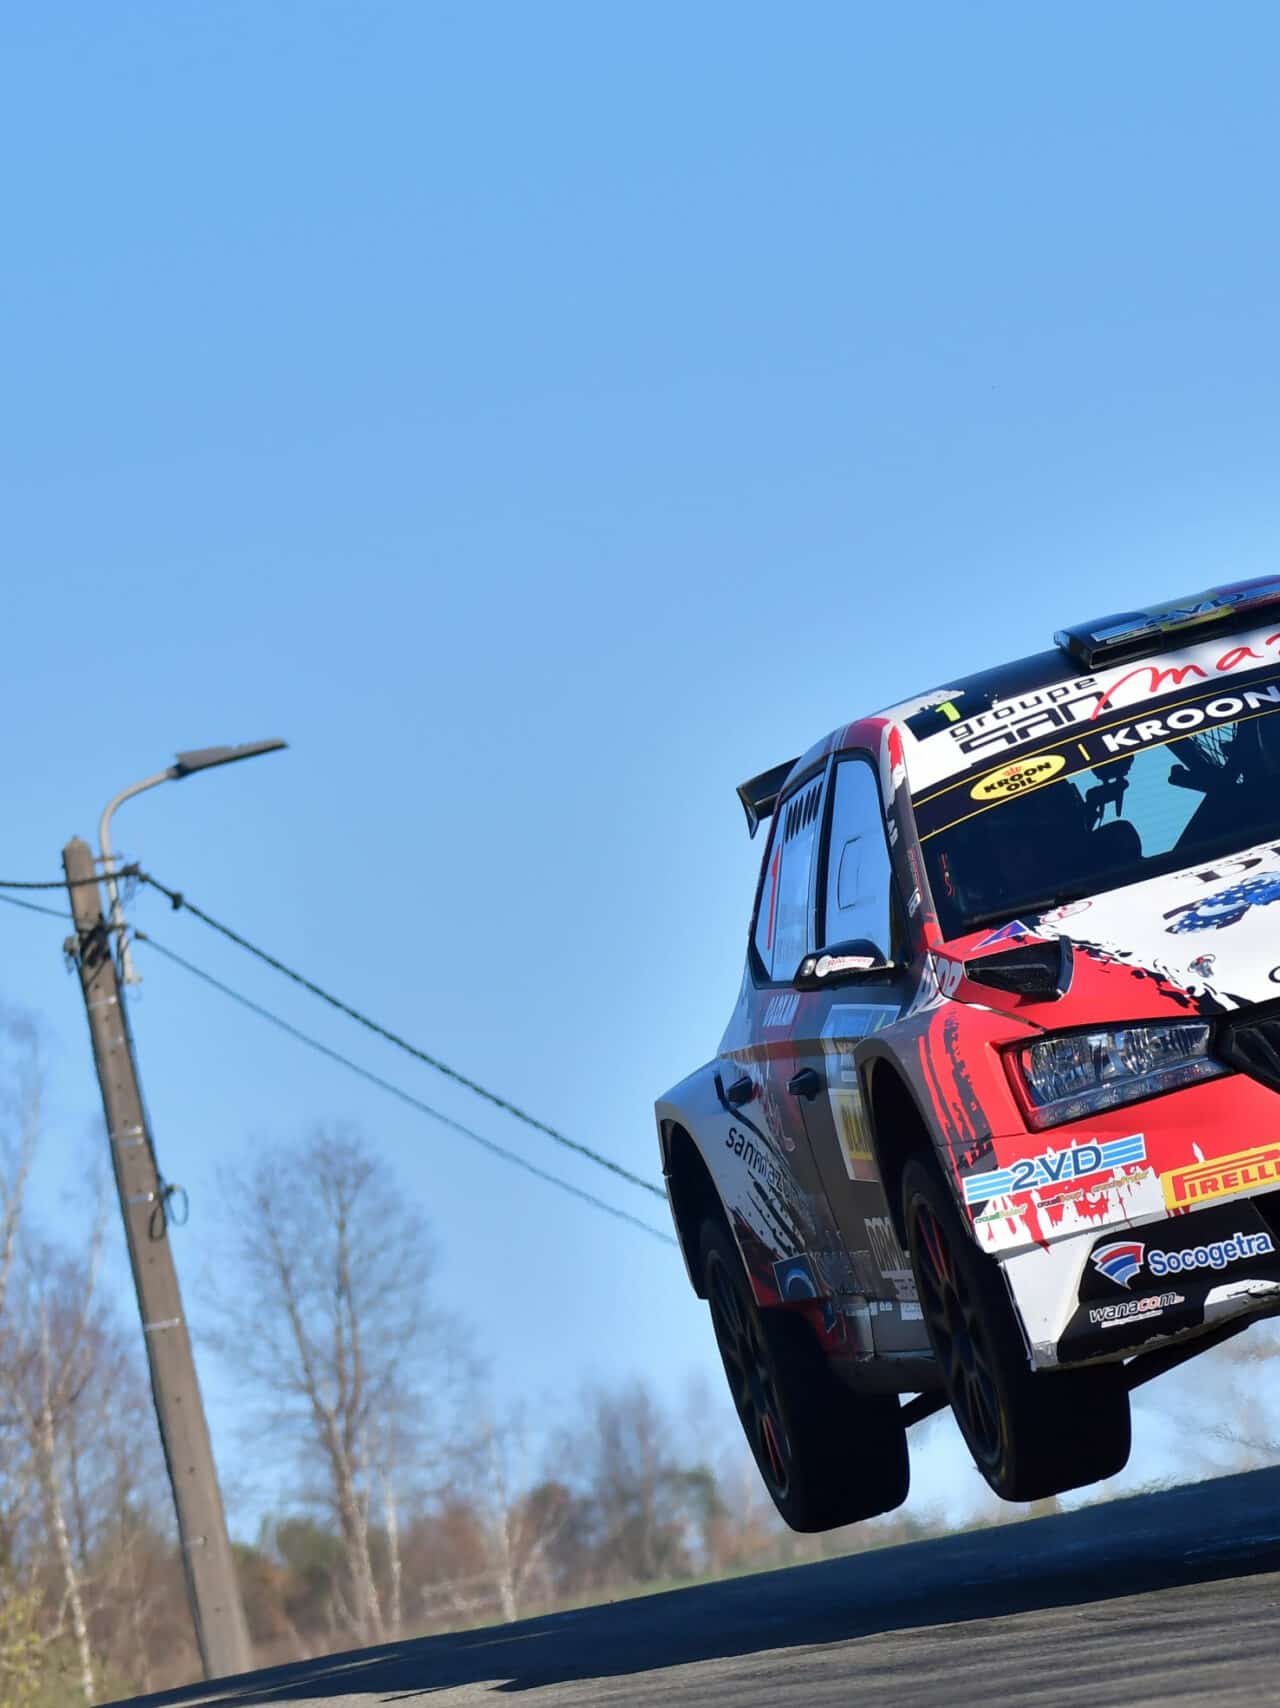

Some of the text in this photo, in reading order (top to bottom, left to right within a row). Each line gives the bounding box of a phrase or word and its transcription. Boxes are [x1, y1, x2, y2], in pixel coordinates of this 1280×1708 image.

[935, 701, 962, 722] 1
[950, 677, 1098, 742] groupe
[983, 761, 1052, 794] KROON
[1006, 779, 1037, 792] OIL
[1011, 1144, 1103, 1191] 2VD
[1149, 1231, 1275, 1277] Socogetra
[1088, 1290, 1178, 1323] wanacom
